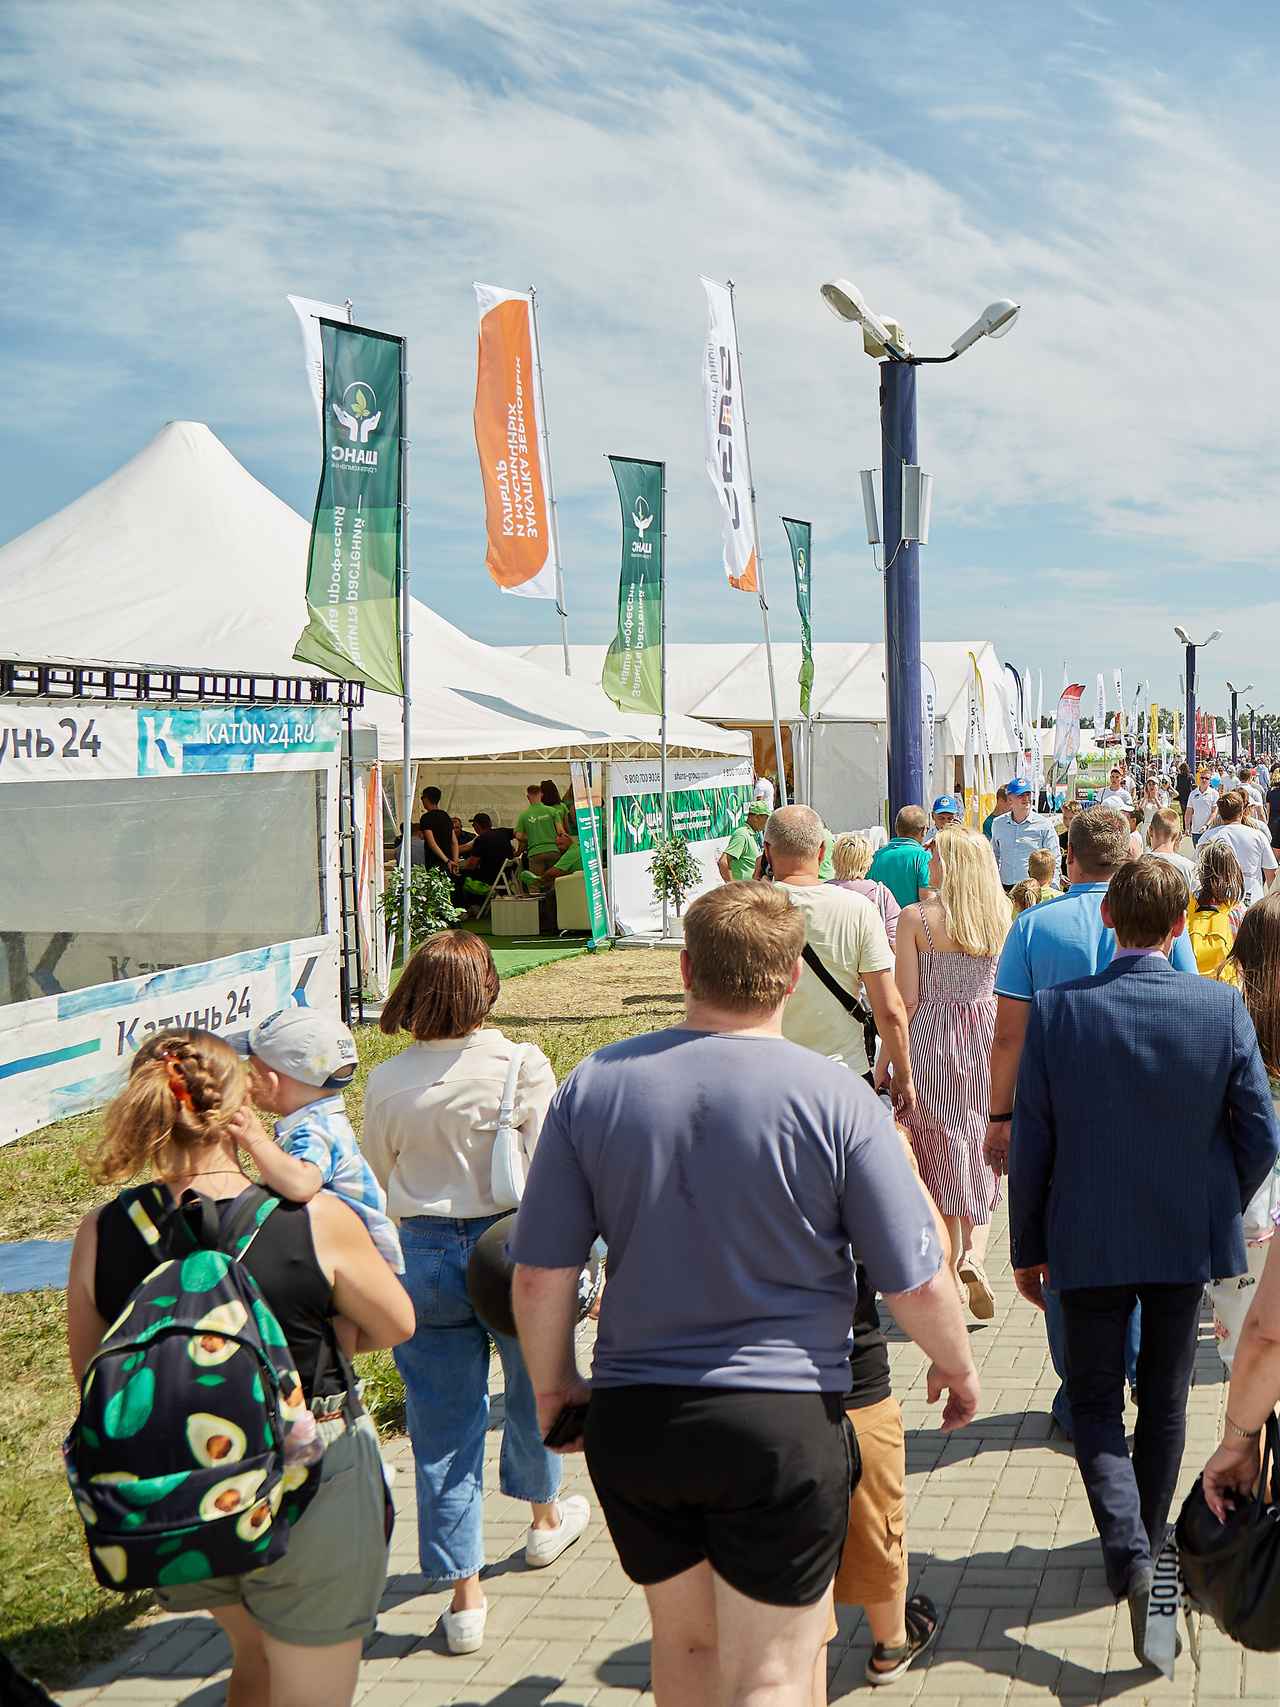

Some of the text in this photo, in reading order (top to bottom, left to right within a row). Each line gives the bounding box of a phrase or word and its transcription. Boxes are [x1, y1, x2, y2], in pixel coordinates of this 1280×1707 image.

[58, 717, 101, 758] 24
[206, 722, 315, 749] KATUN 24.RU
[225, 986, 252, 1025] 24
